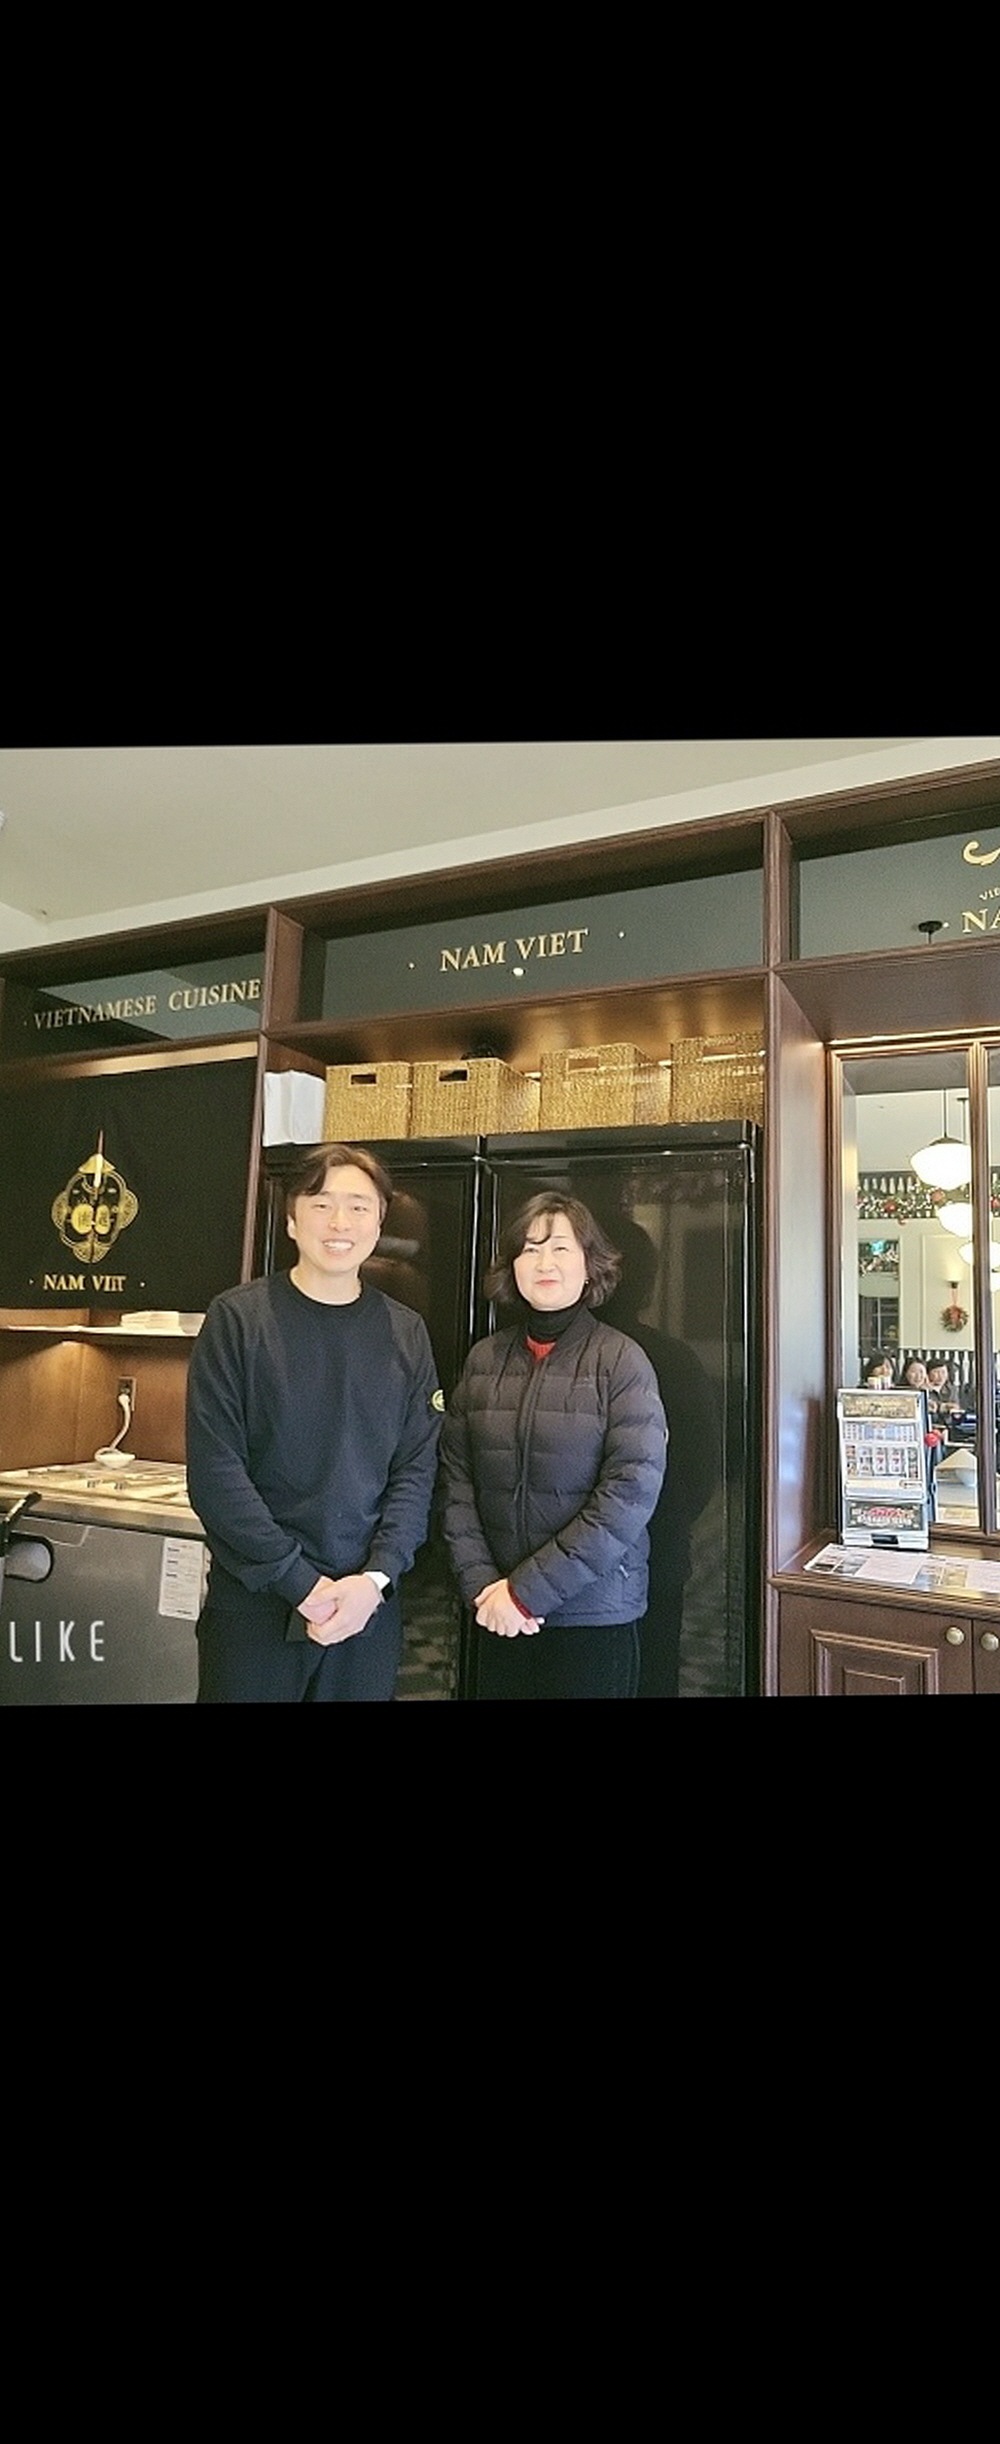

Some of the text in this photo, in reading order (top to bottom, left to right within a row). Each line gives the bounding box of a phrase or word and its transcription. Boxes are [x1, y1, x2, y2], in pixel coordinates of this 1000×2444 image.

[440, 928, 589, 972] NAM VIET
[34, 978, 262, 1030] VIETNAMESE CUISINE
[43, 1274, 86, 1291] NAM
